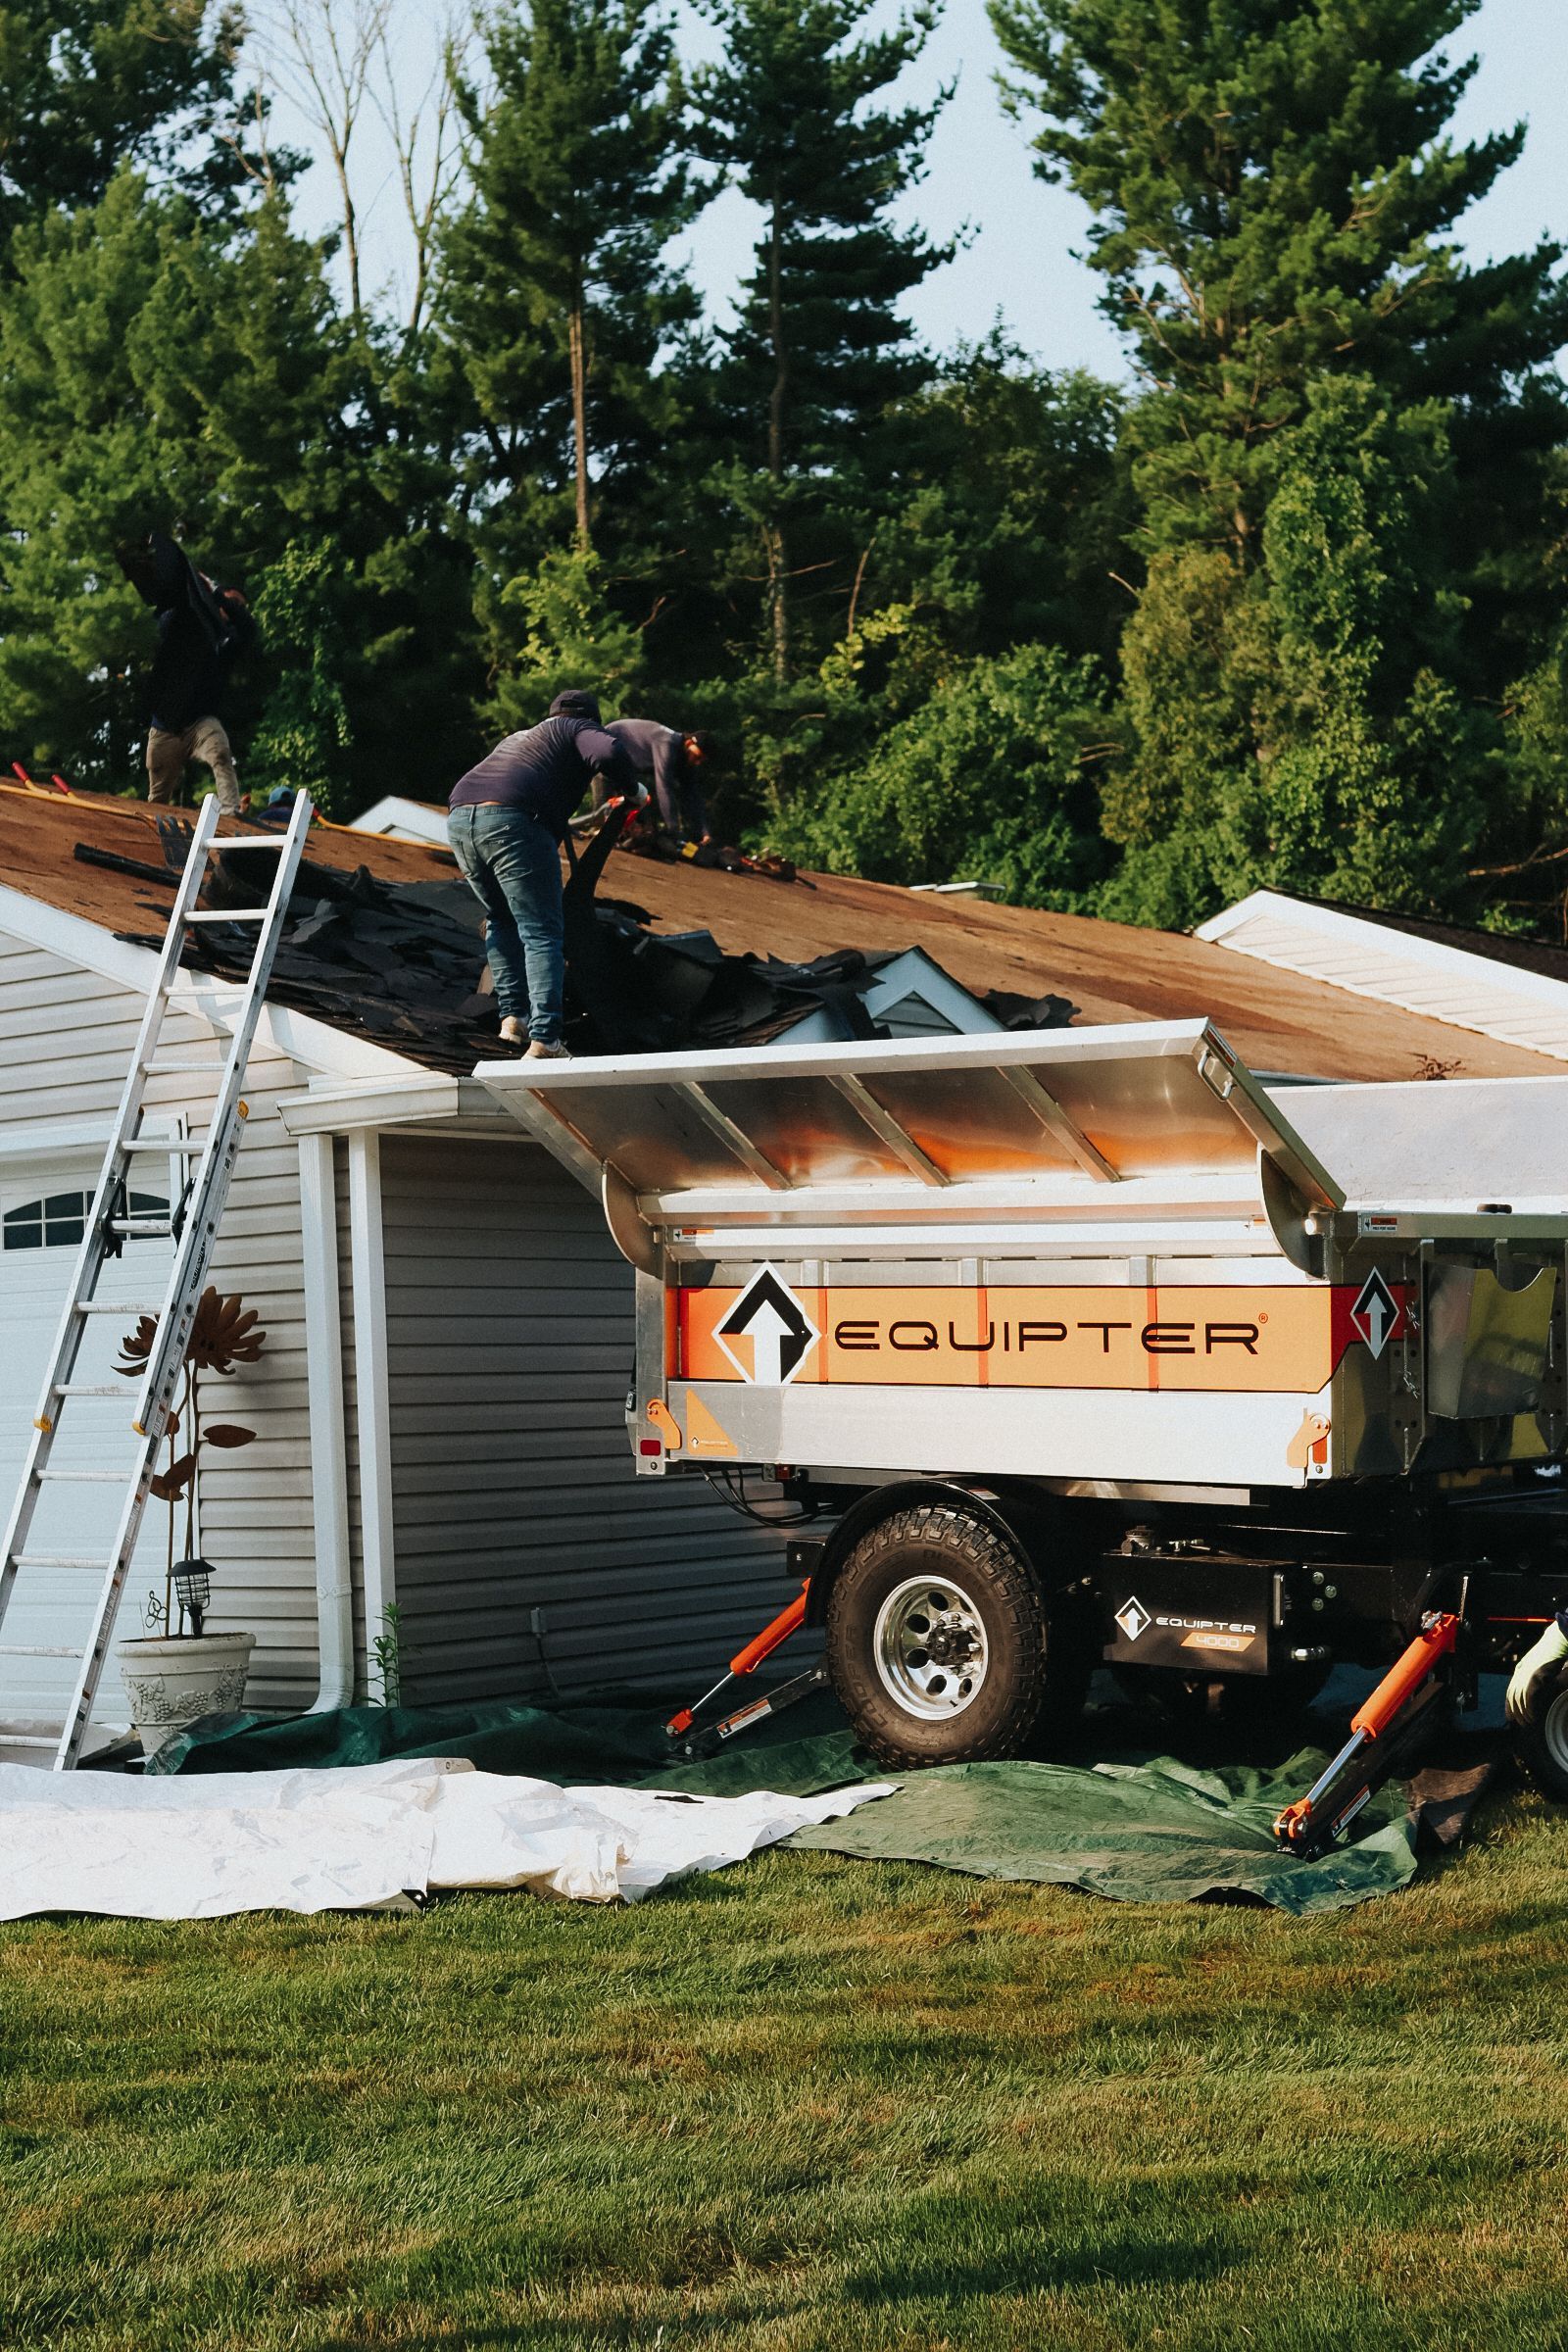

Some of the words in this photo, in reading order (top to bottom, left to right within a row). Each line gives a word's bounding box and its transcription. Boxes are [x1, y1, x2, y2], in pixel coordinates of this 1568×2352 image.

[834, 1320, 1259, 1354] EQUIPTER
[1155, 1616, 1256, 1634] EQUIPTER
[1196, 1636, 1240, 1648] 4000
